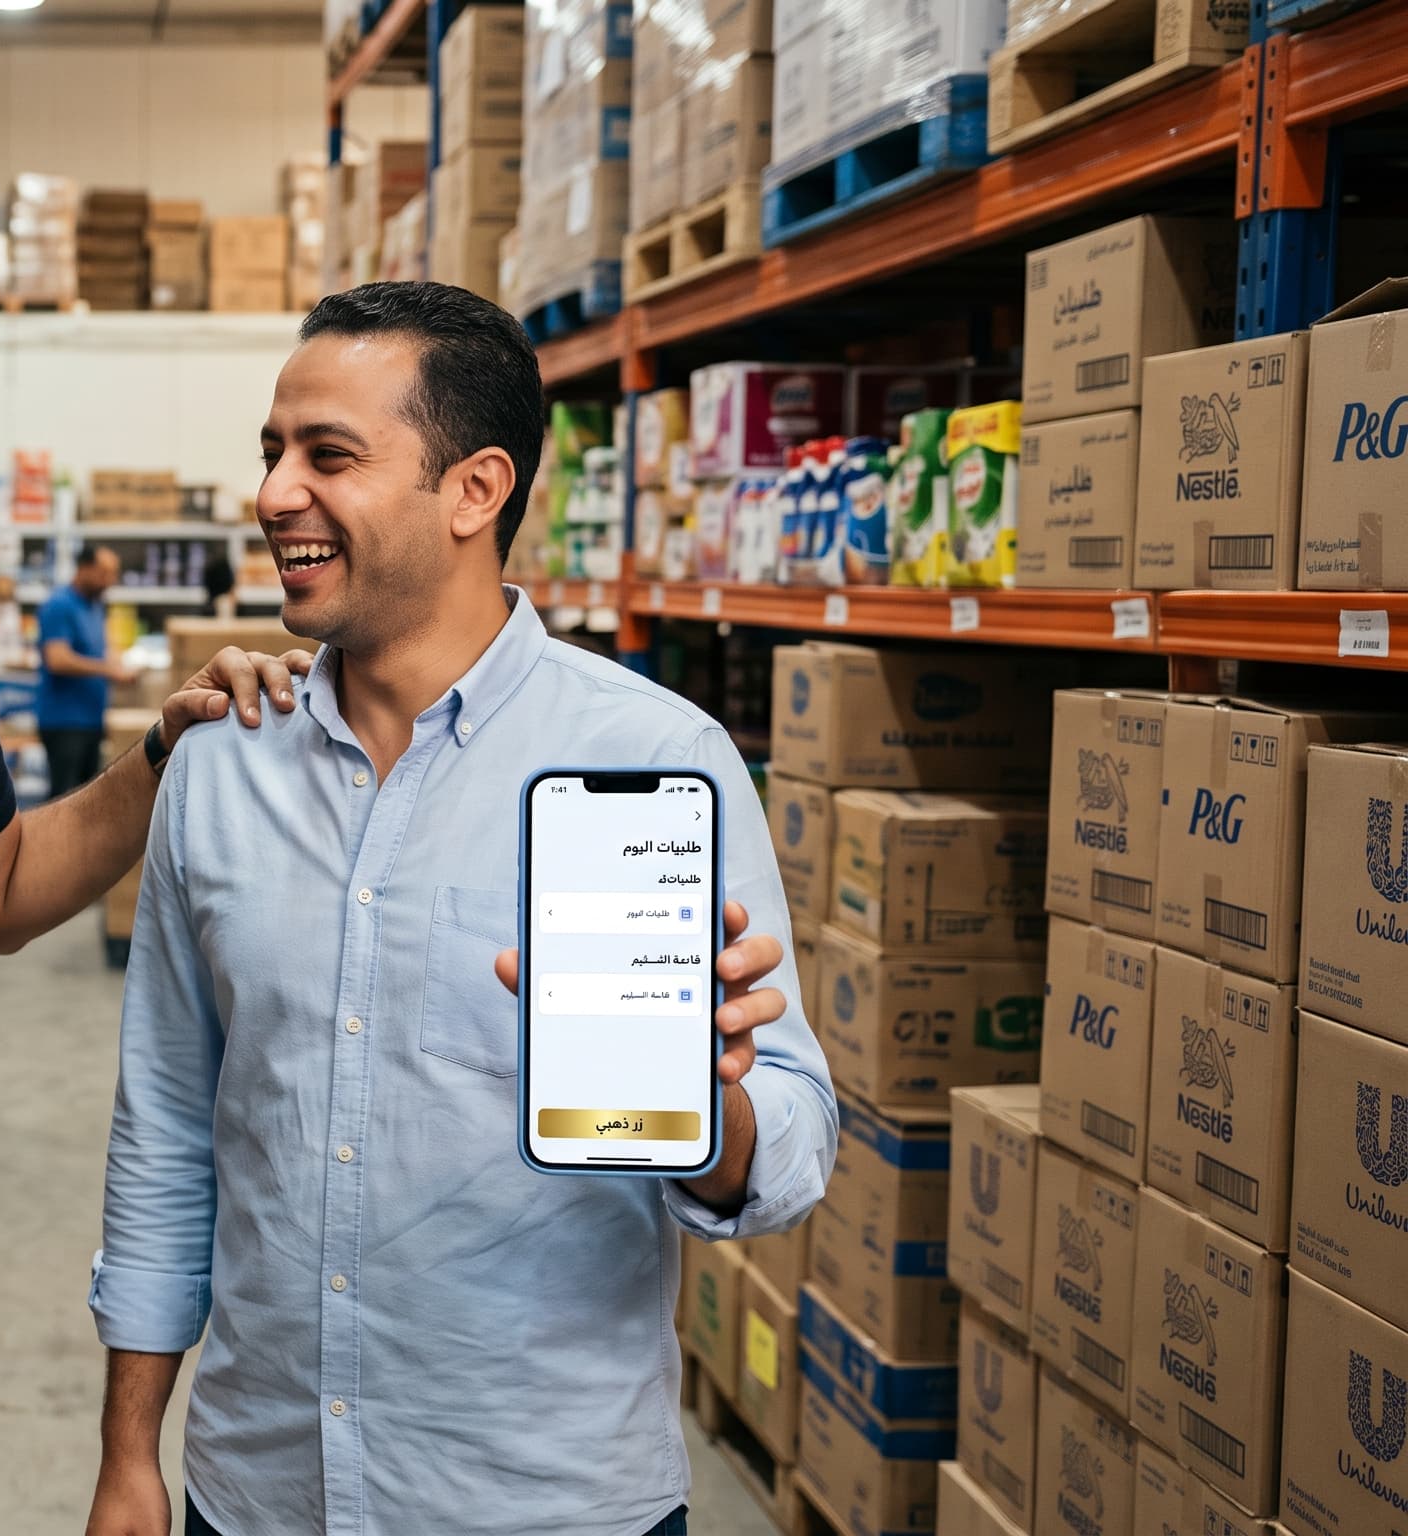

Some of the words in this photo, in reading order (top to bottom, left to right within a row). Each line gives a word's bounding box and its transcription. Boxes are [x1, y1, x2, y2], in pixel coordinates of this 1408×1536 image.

[1333, 394, 1408, 462] P&G
[1188, 787, 1247, 844] P&G
[623, 840, 653, 857] اليوم
[657, 840, 702, 856] طلبيات
[1356, 907, 1408, 946] Unile
[1070, 994, 1119, 1049] P&G
[596, 1117, 629, 1135] ذهبي
[632, 1118, 643, 1132] زر
[1346, 1182, 1408, 1233] Unilev
